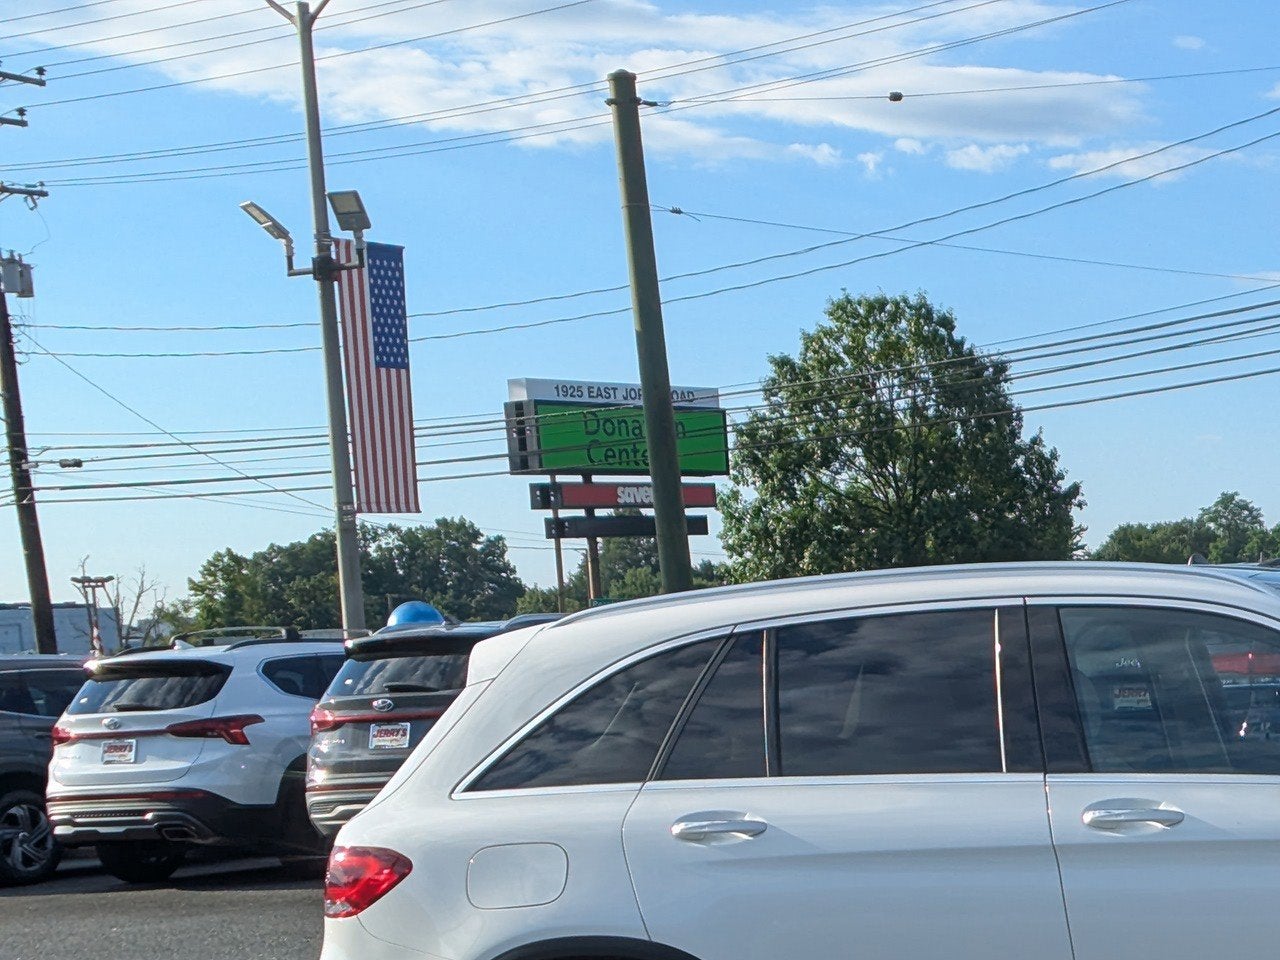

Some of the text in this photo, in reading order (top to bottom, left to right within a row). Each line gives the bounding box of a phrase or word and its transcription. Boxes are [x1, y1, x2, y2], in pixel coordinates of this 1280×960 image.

[554, 384, 695, 402] 1925 EAST JOP OAD
[582, 411, 686, 439] Donan
[587, 439, 649, 466] Cente
